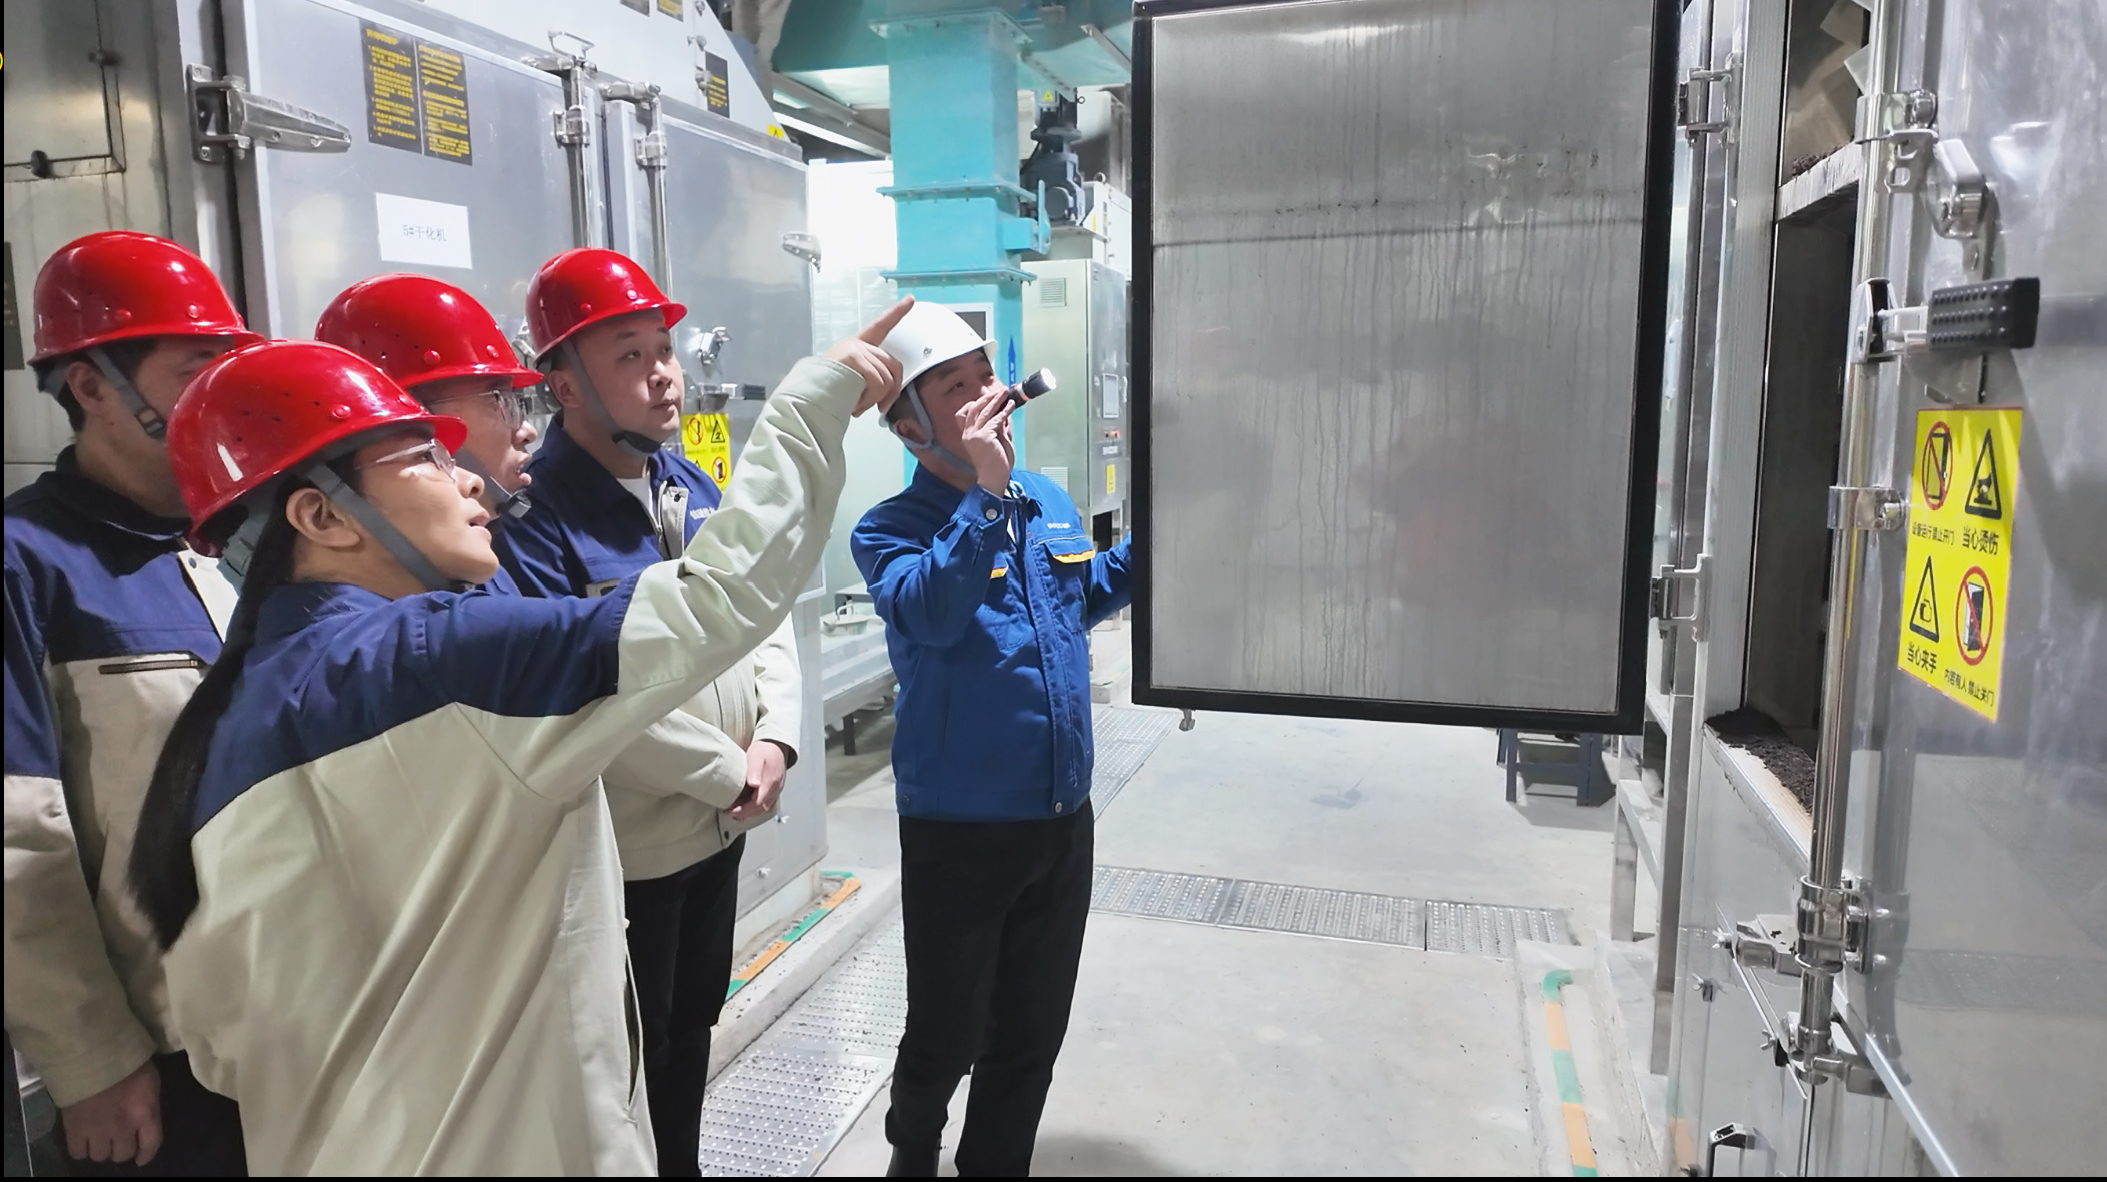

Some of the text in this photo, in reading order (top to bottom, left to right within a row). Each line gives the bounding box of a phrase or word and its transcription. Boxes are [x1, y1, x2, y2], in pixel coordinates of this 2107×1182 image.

[1962, 525, 1999, 555] 当心烫伤
[1907, 641, 1937, 674] 当心夹手
